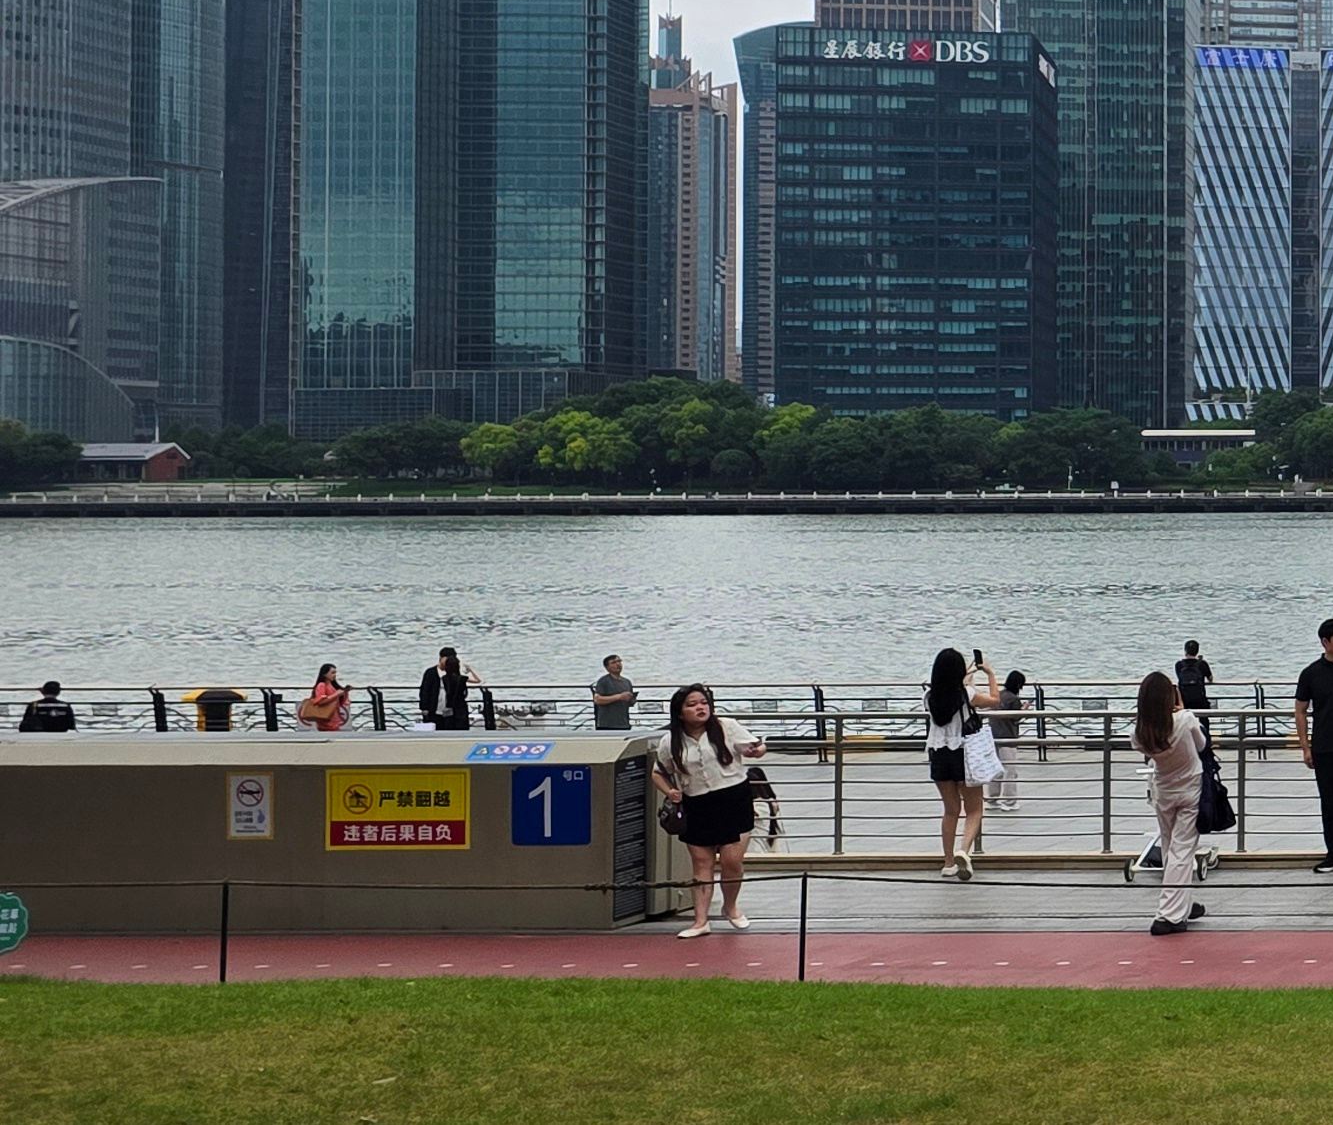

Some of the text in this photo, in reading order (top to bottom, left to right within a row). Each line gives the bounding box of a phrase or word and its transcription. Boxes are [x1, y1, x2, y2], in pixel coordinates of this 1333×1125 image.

[935, 40, 990, 64] DBS
[378, 789, 451, 808] 严禁翻越
[527, 776, 552, 838] 1
[343, 823, 452, 842] 违者后果自负
